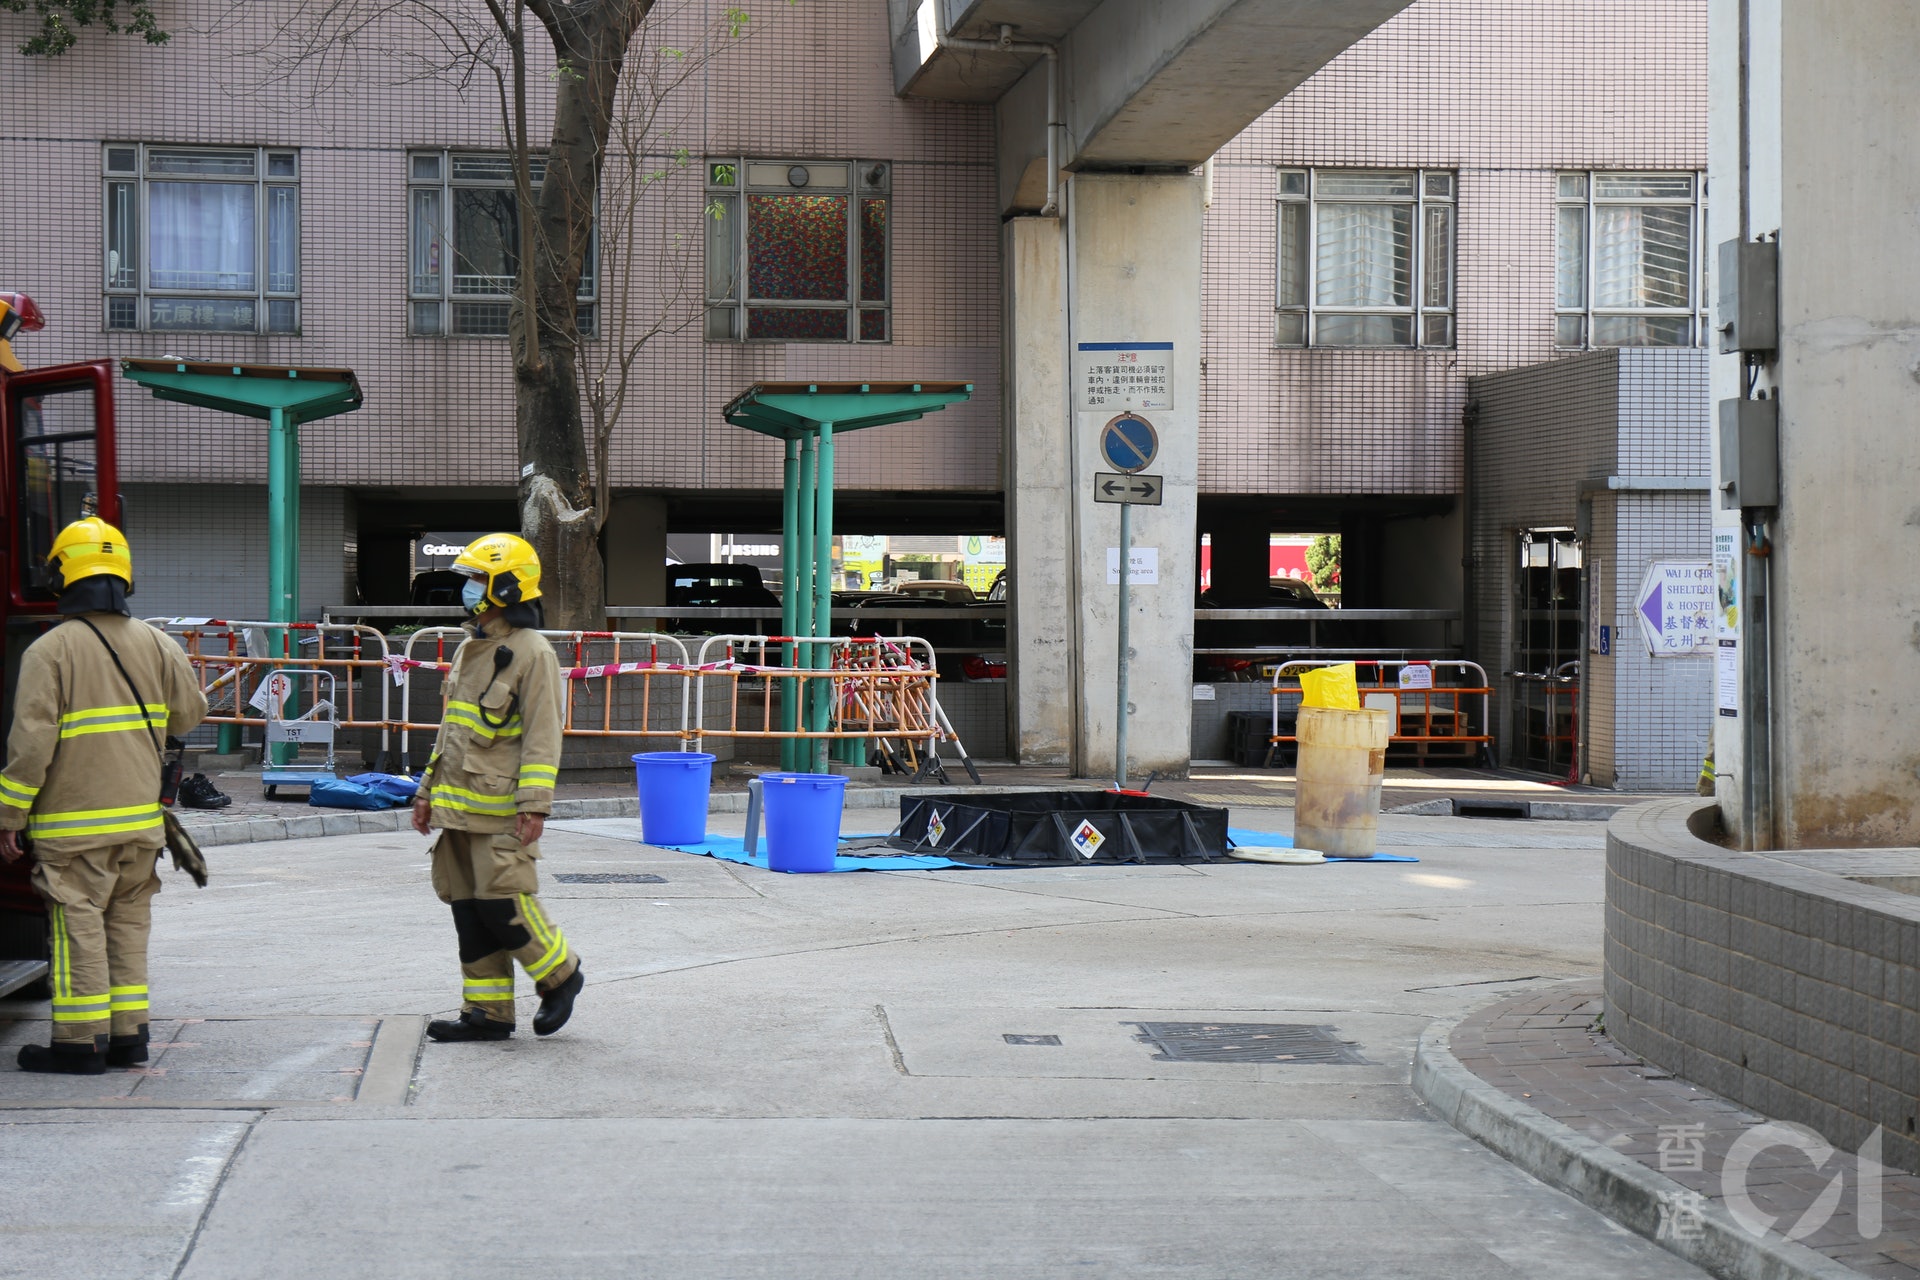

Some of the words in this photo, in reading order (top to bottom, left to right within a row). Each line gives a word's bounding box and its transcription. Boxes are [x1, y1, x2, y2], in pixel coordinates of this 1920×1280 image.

[151, 303, 254, 326] 元康樓一樓
[1117, 352, 1138, 362] 注意
[1087, 365, 1166, 375] 上落客貨司機必須留守
[720, 544, 780, 556] AMSUNG
[1665, 568, 1681, 578] WAI
[1684, 568, 1691, 578] JI
[1666, 601, 1674, 610] &
[1664, 615, 1714, 630] 基督教
[286, 728, 302, 736] TST
